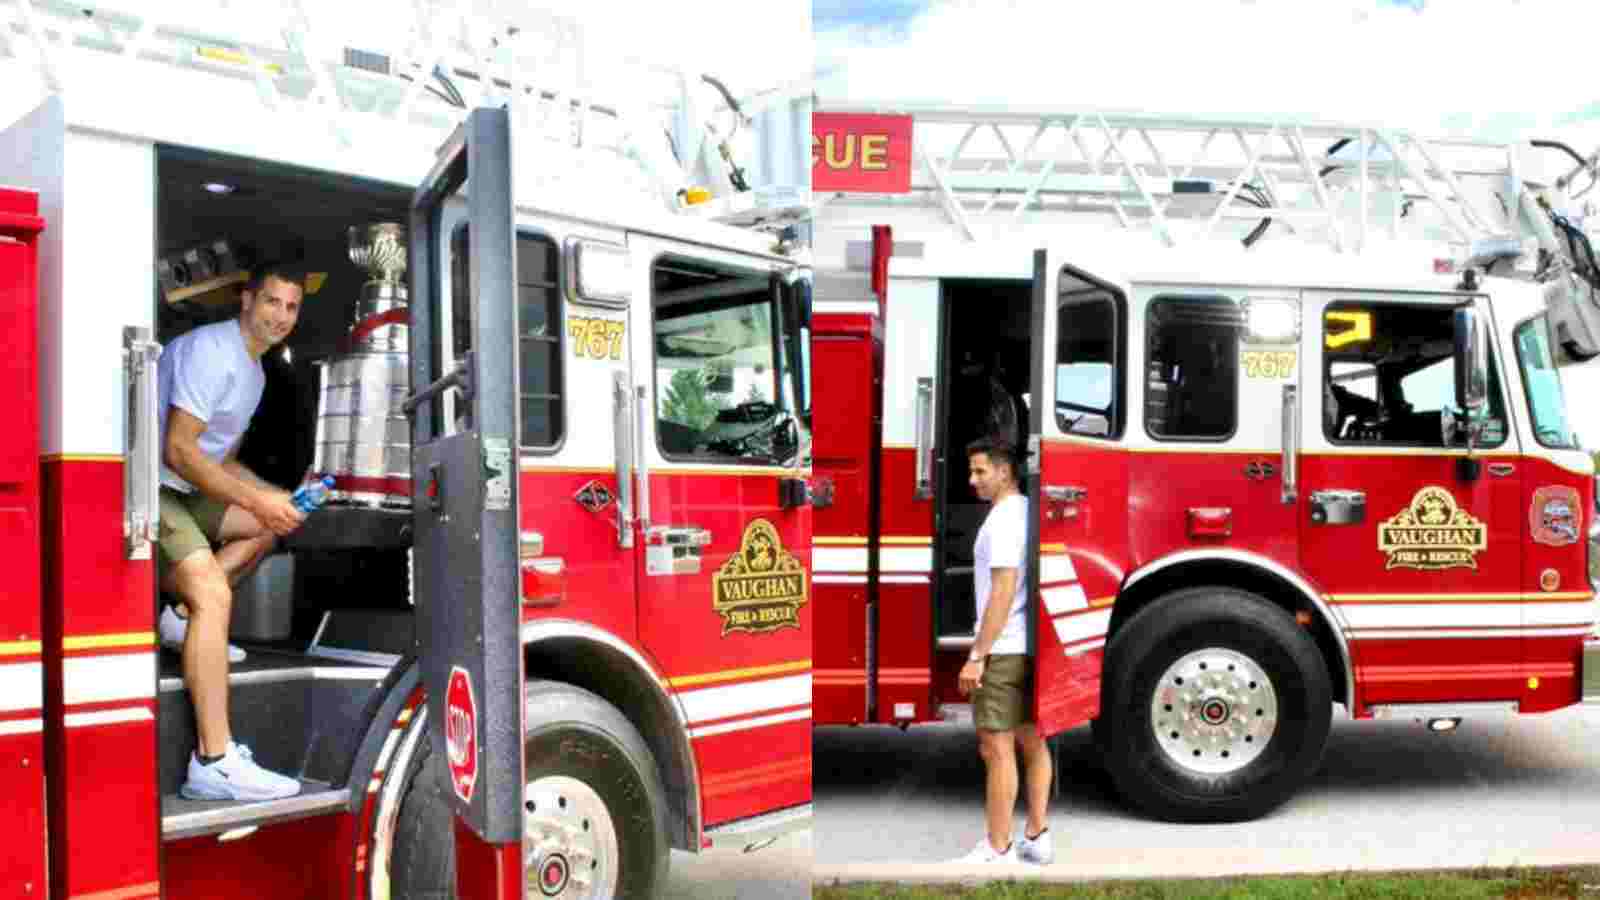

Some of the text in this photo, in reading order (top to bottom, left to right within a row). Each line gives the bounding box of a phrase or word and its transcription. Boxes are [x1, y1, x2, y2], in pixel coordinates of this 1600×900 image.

[568, 319, 625, 360] 767
[1241, 351, 1296, 378] 767
[1388, 529, 1477, 545] VAUGHAN
[721, 576, 798, 600] VAUGHAN
